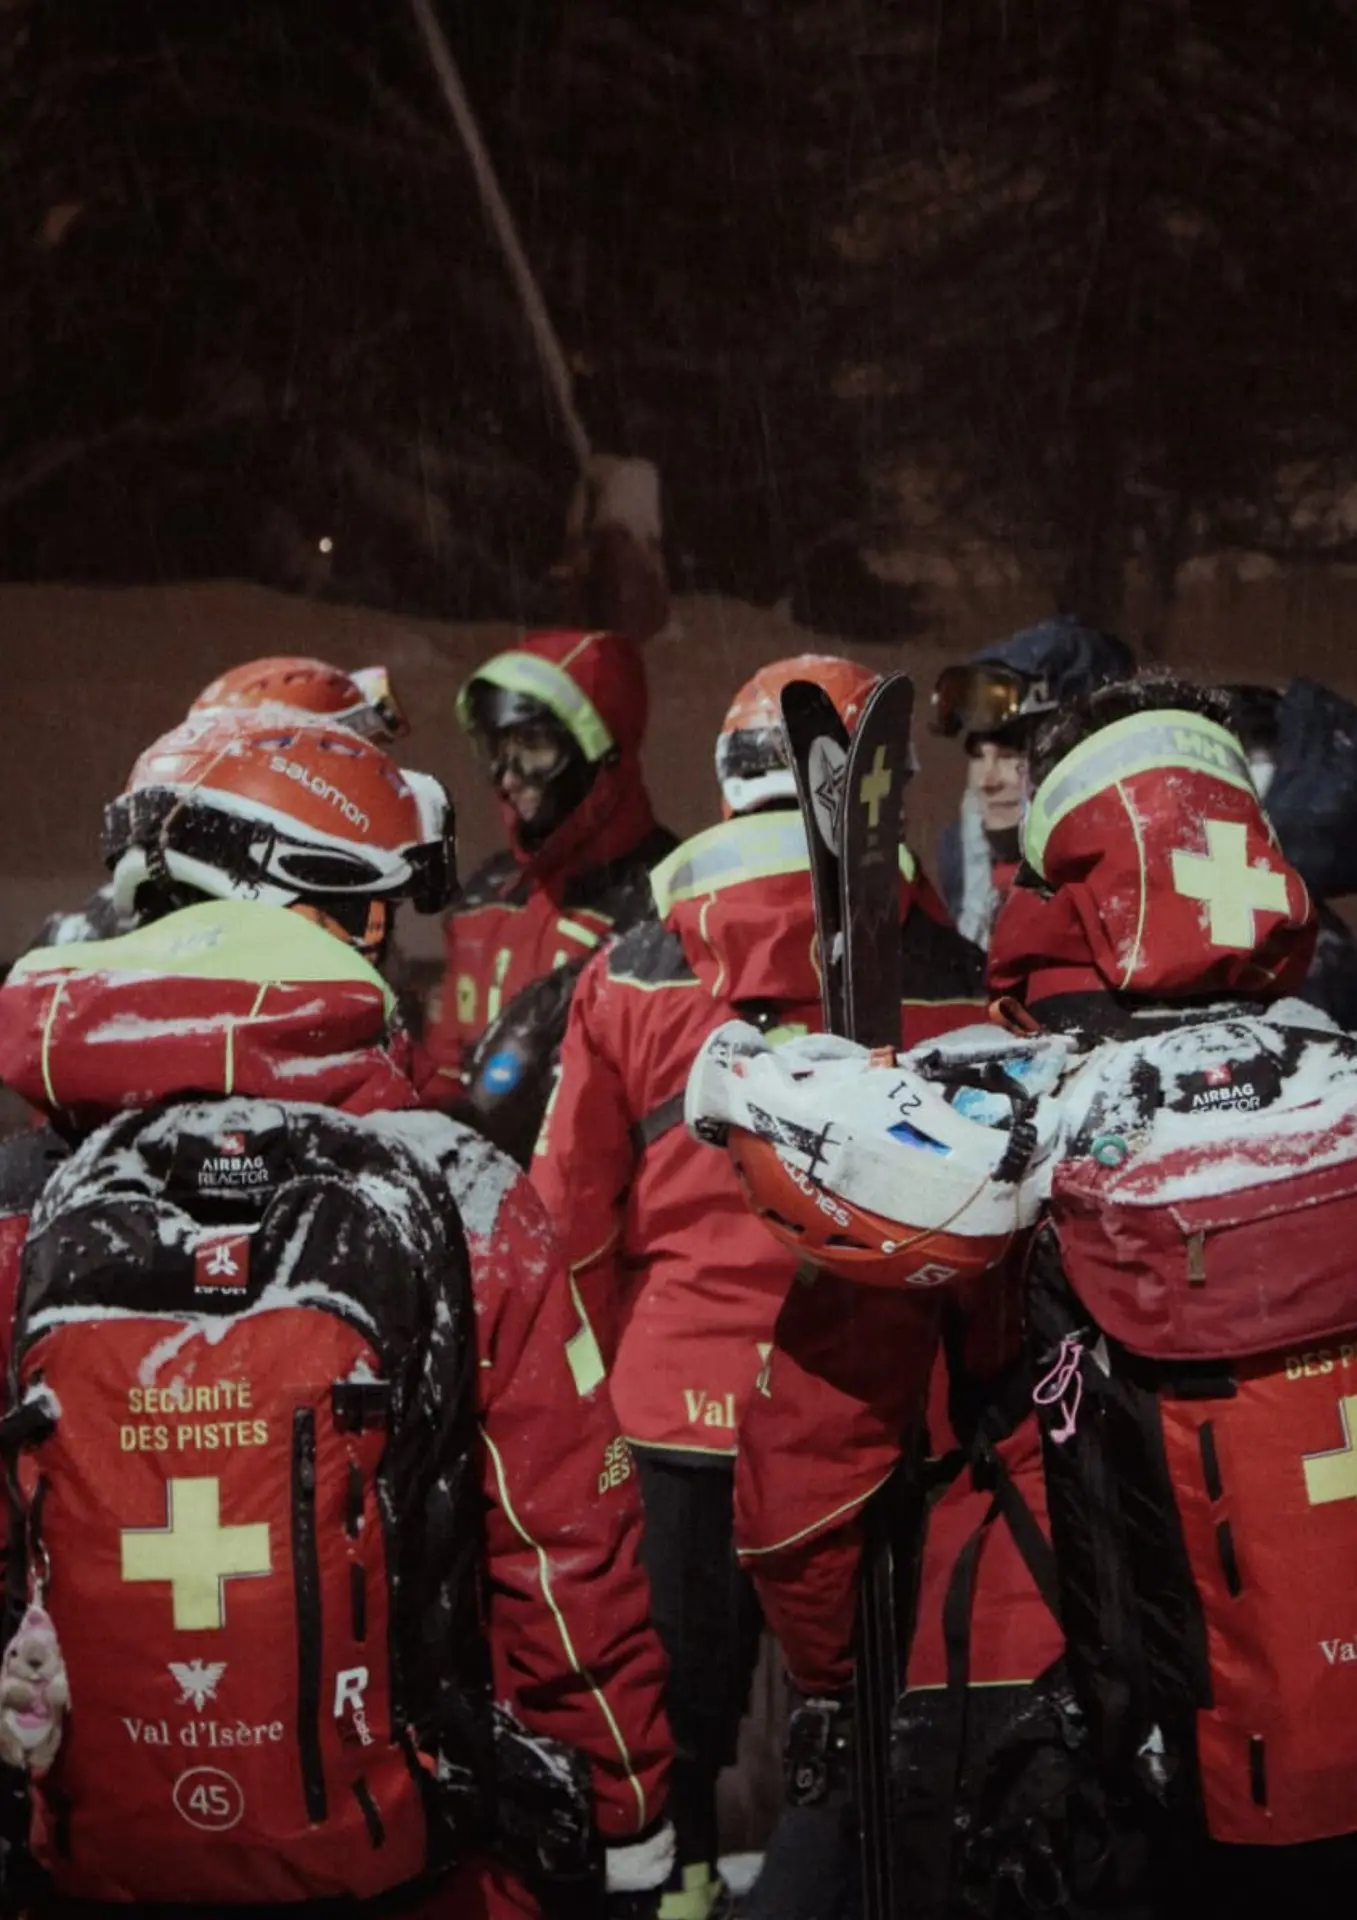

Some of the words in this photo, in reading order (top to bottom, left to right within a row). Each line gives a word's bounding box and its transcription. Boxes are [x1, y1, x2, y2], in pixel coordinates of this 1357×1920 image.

[269, 755, 370, 833] salomon
[1193, 1083, 1254, 1107] AIRBAG
[198, 1168, 269, 1186] REACTOR
[202, 1156, 264, 1171] AIRBAG
[684, 1388, 735, 1428] Val
[119, 1424, 169, 1451] DES
[177, 1418, 268, 1450] PISTES
[122, 1717, 171, 1746] Val
[189, 1783, 230, 1816] 45
